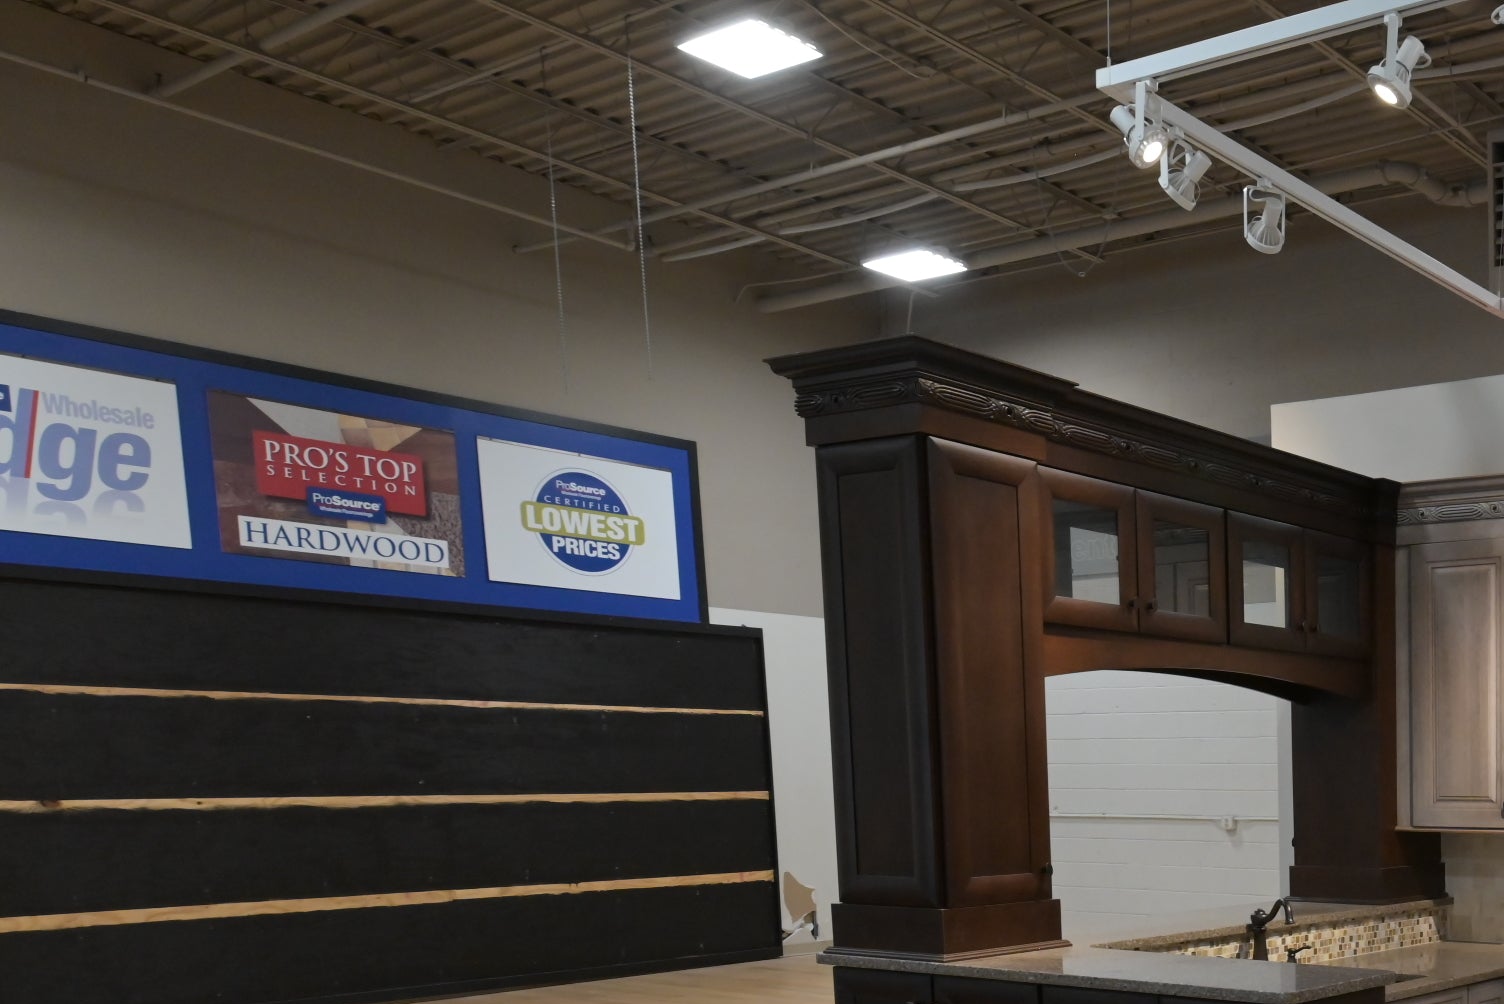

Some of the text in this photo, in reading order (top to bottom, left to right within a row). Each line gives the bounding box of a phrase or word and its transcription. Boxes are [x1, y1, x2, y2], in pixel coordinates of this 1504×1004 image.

[42, 391, 155, 430] Wholesale
[263, 439, 417, 483] PRO'S TOP
[267, 464, 416, 496] SELECTION
[555, 479, 606, 496] ProSource
[312, 492, 380, 511] ProSource
[543, 495, 620, 513] CERTIFIED
[525, 504, 639, 542] LOWEST
[244, 520, 445, 564] HARDWOOD
[551, 535, 620, 560] PRICES
